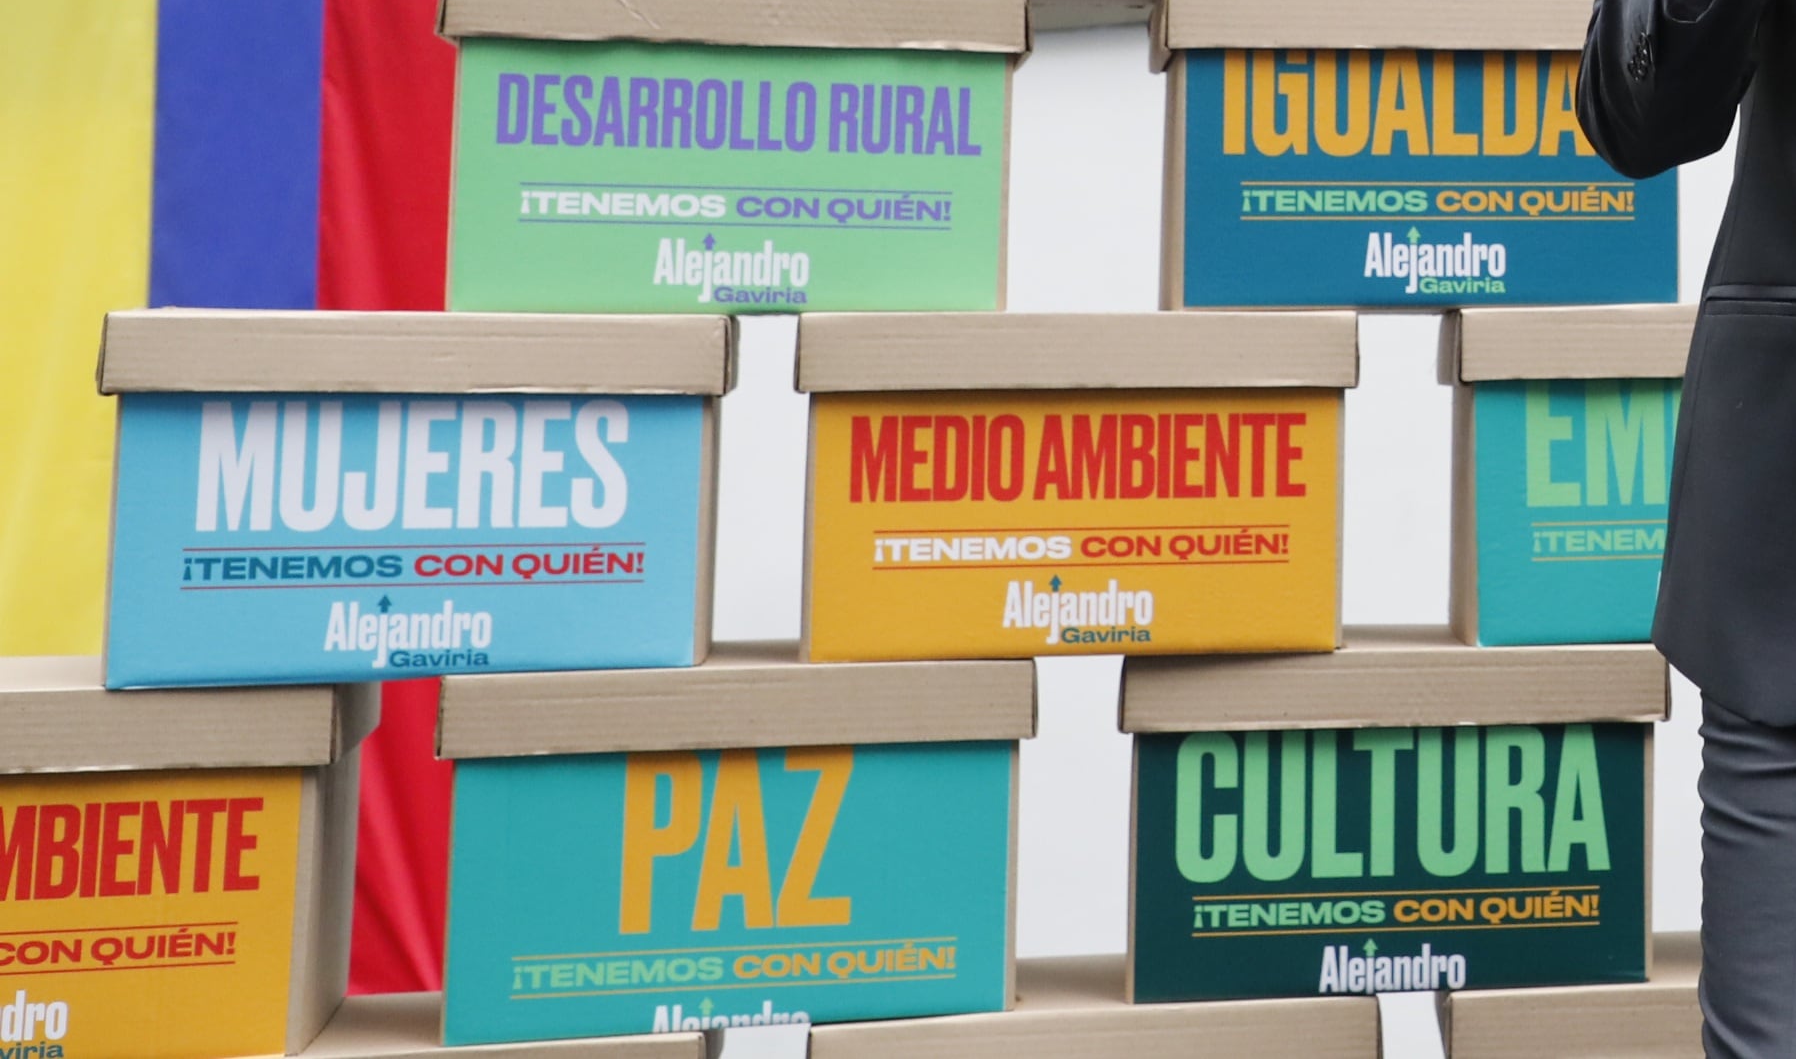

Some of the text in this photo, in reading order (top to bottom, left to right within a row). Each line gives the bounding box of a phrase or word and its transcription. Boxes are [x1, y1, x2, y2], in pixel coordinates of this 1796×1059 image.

[496, 73, 982, 156] DESARROLLO RURAL
[1223, 50, 1597, 157] IGUALDA
[520, 190, 951, 224] ¡TENEMOS CON QUIÉN!
[1242, 186, 1634, 216] ¡TENEMOS CON QUIÉN!
[654, 238, 809, 303] Alejandro
[1364, 232, 1506, 294] Alejandro
[1419, 277, 1505, 294] Gaviria
[713, 287, 807, 304] Gaviria
[195, 399, 629, 532] MUJERES
[849, 413, 1307, 503] MEDIO AMBIENTE
[183, 547, 644, 581] ¡TENEMOS CON QUIÉN!
[874, 530, 1289, 563] ¡TENEMOS CON QUIÉN!
[325, 600, 492, 669] Alejandro
[1003, 579, 1154, 645] Alejandro
[1061, 626, 1151, 644] Gaviria
[390, 649, 489, 668] Gaviria
[1175, 725, 1610, 883] CULTURA
[619, 745, 854, 935] PAZ
[1194, 890, 1599, 929] ¡TENEMOS CON QUIÉN!
[91, 928, 236, 966] QUIÉN!
[513, 943, 956, 990] ¡TENEMOS CON QUIÉN!
